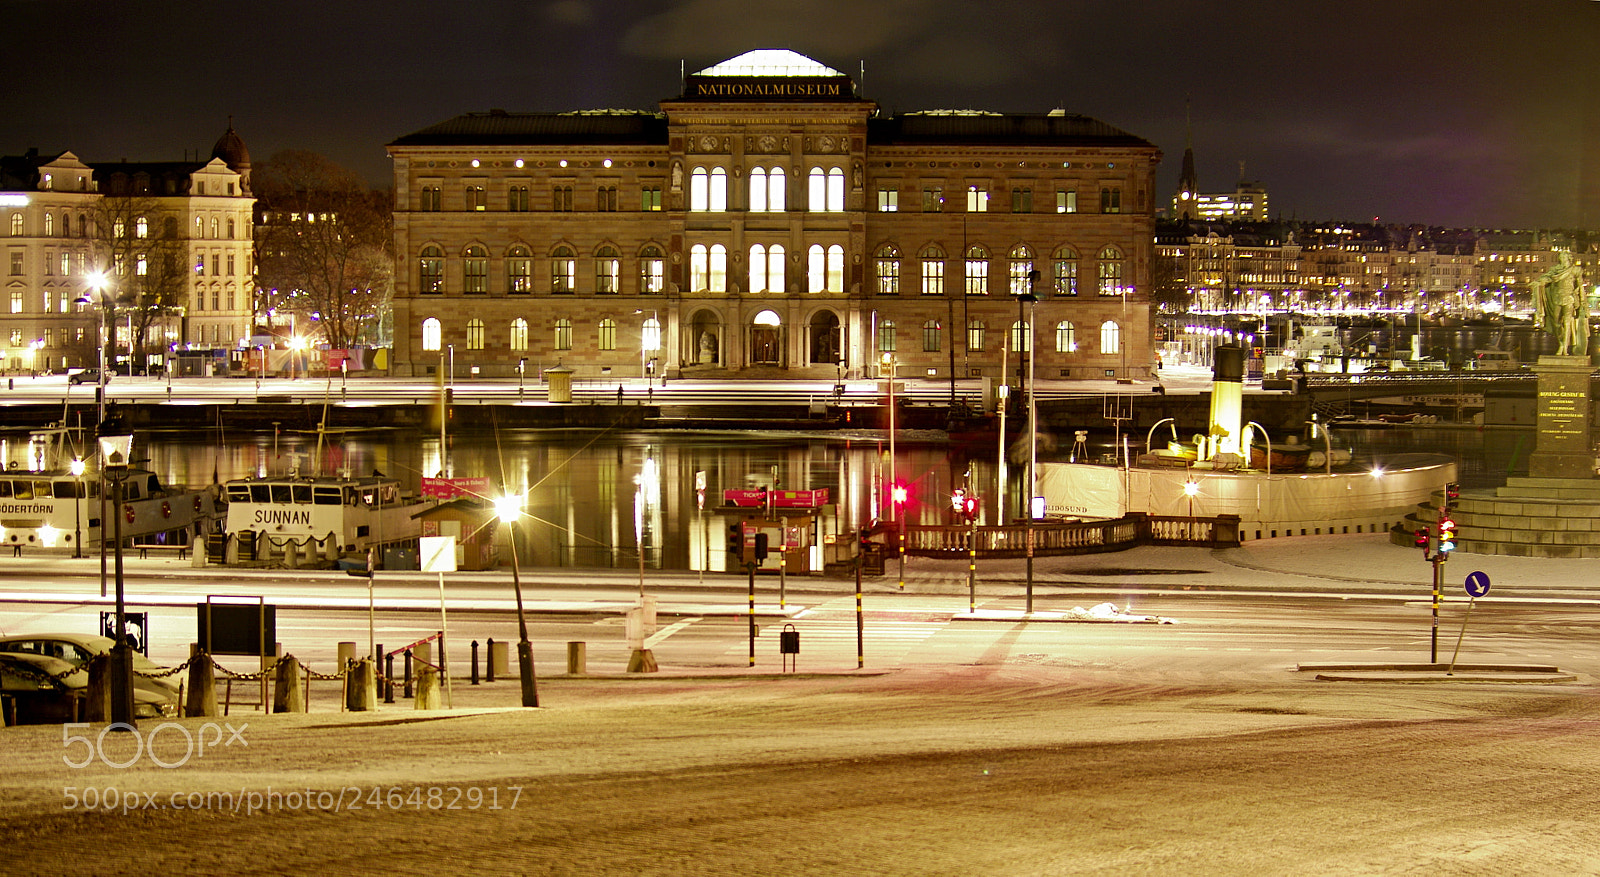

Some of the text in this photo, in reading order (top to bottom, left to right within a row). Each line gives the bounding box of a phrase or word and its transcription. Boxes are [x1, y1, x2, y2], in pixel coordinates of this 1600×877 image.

[698, 84, 840, 96] NATIONALMUSEUM
[0, 502, 54, 514] ÖDERTÖRN
[255, 509, 310, 525] SUNNAN
